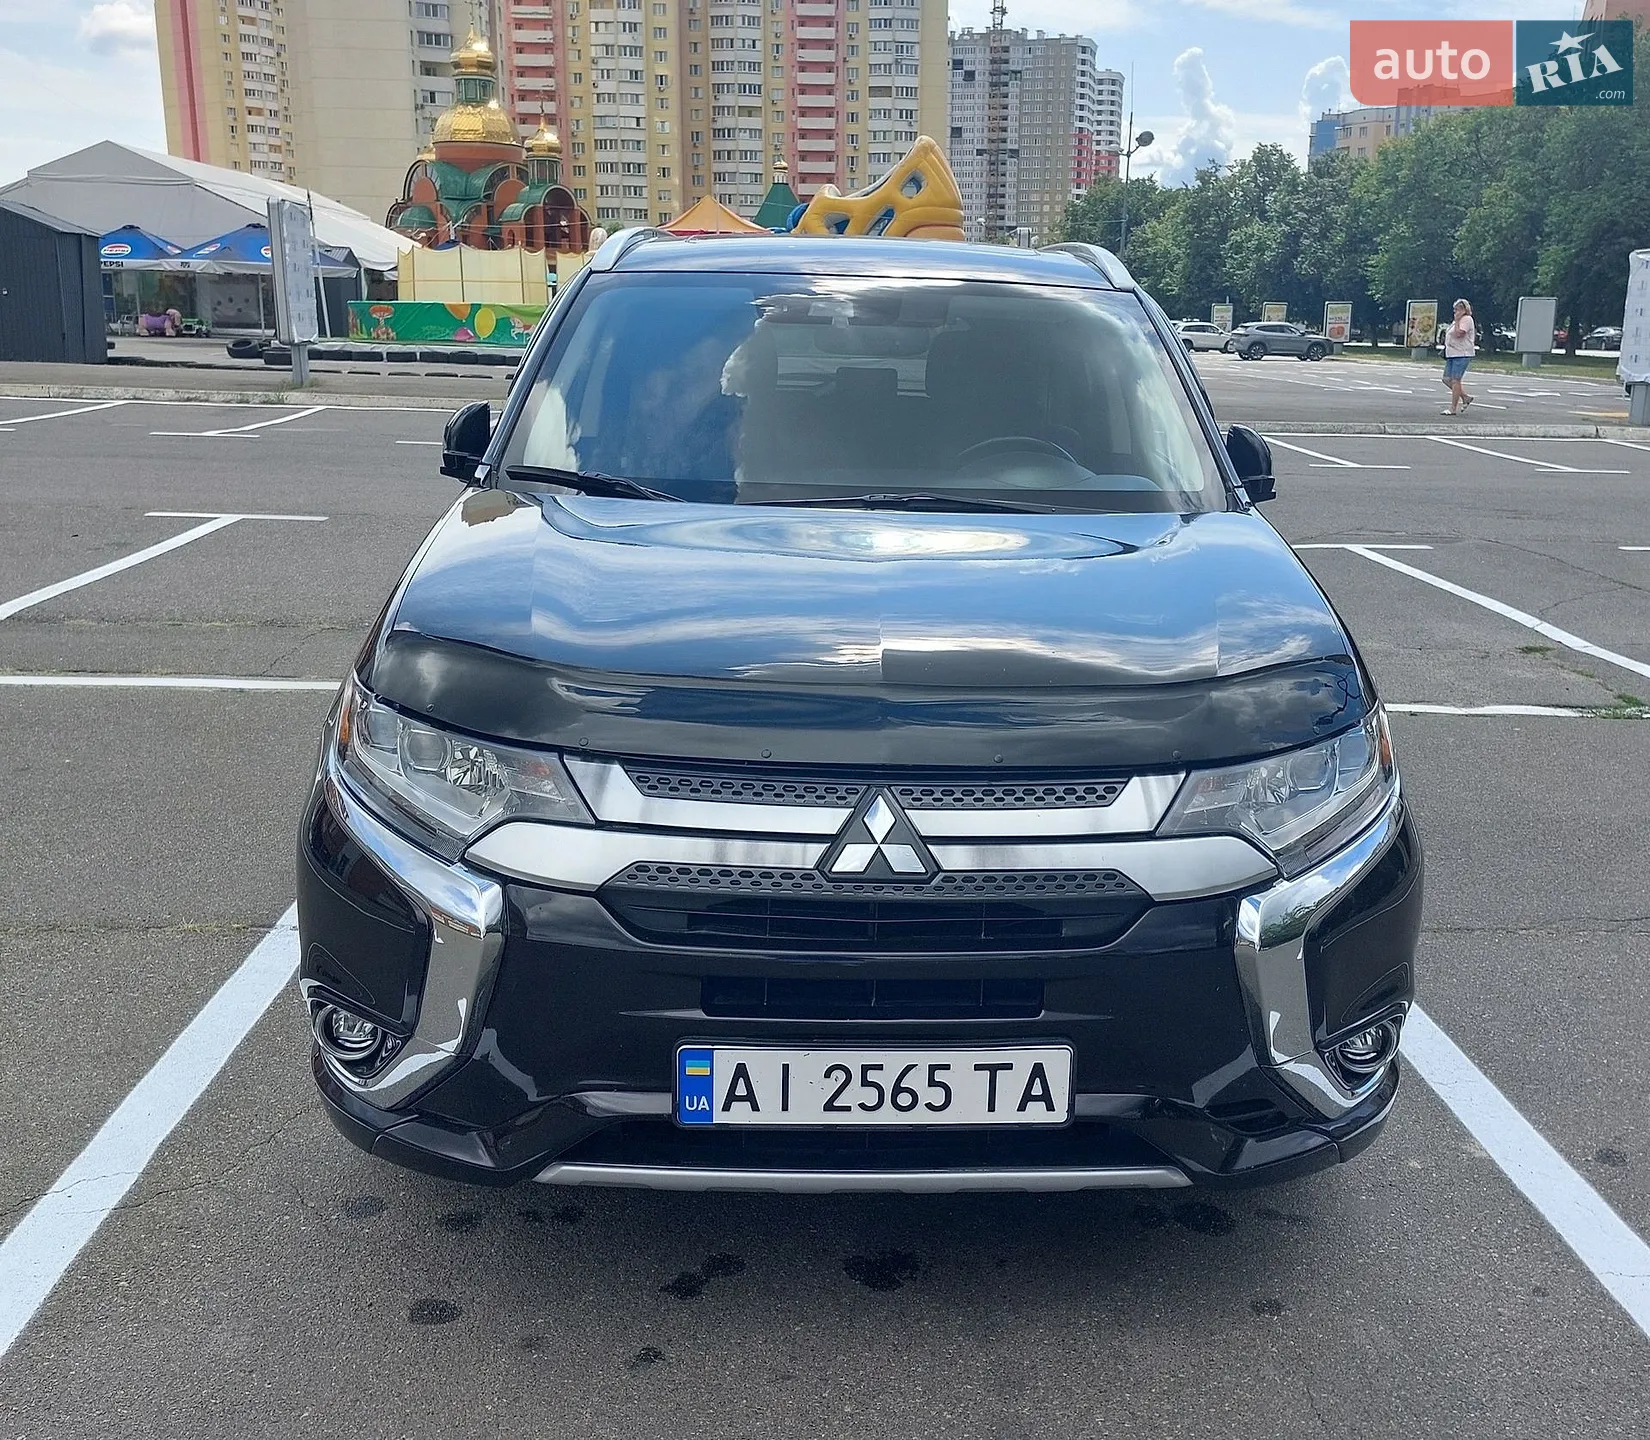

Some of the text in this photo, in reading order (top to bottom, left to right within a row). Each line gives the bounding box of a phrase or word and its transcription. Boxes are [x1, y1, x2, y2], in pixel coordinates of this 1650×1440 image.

[685, 1095, 710, 1111] UA
[721, 1062, 1056, 1112] AI 2565 TA
